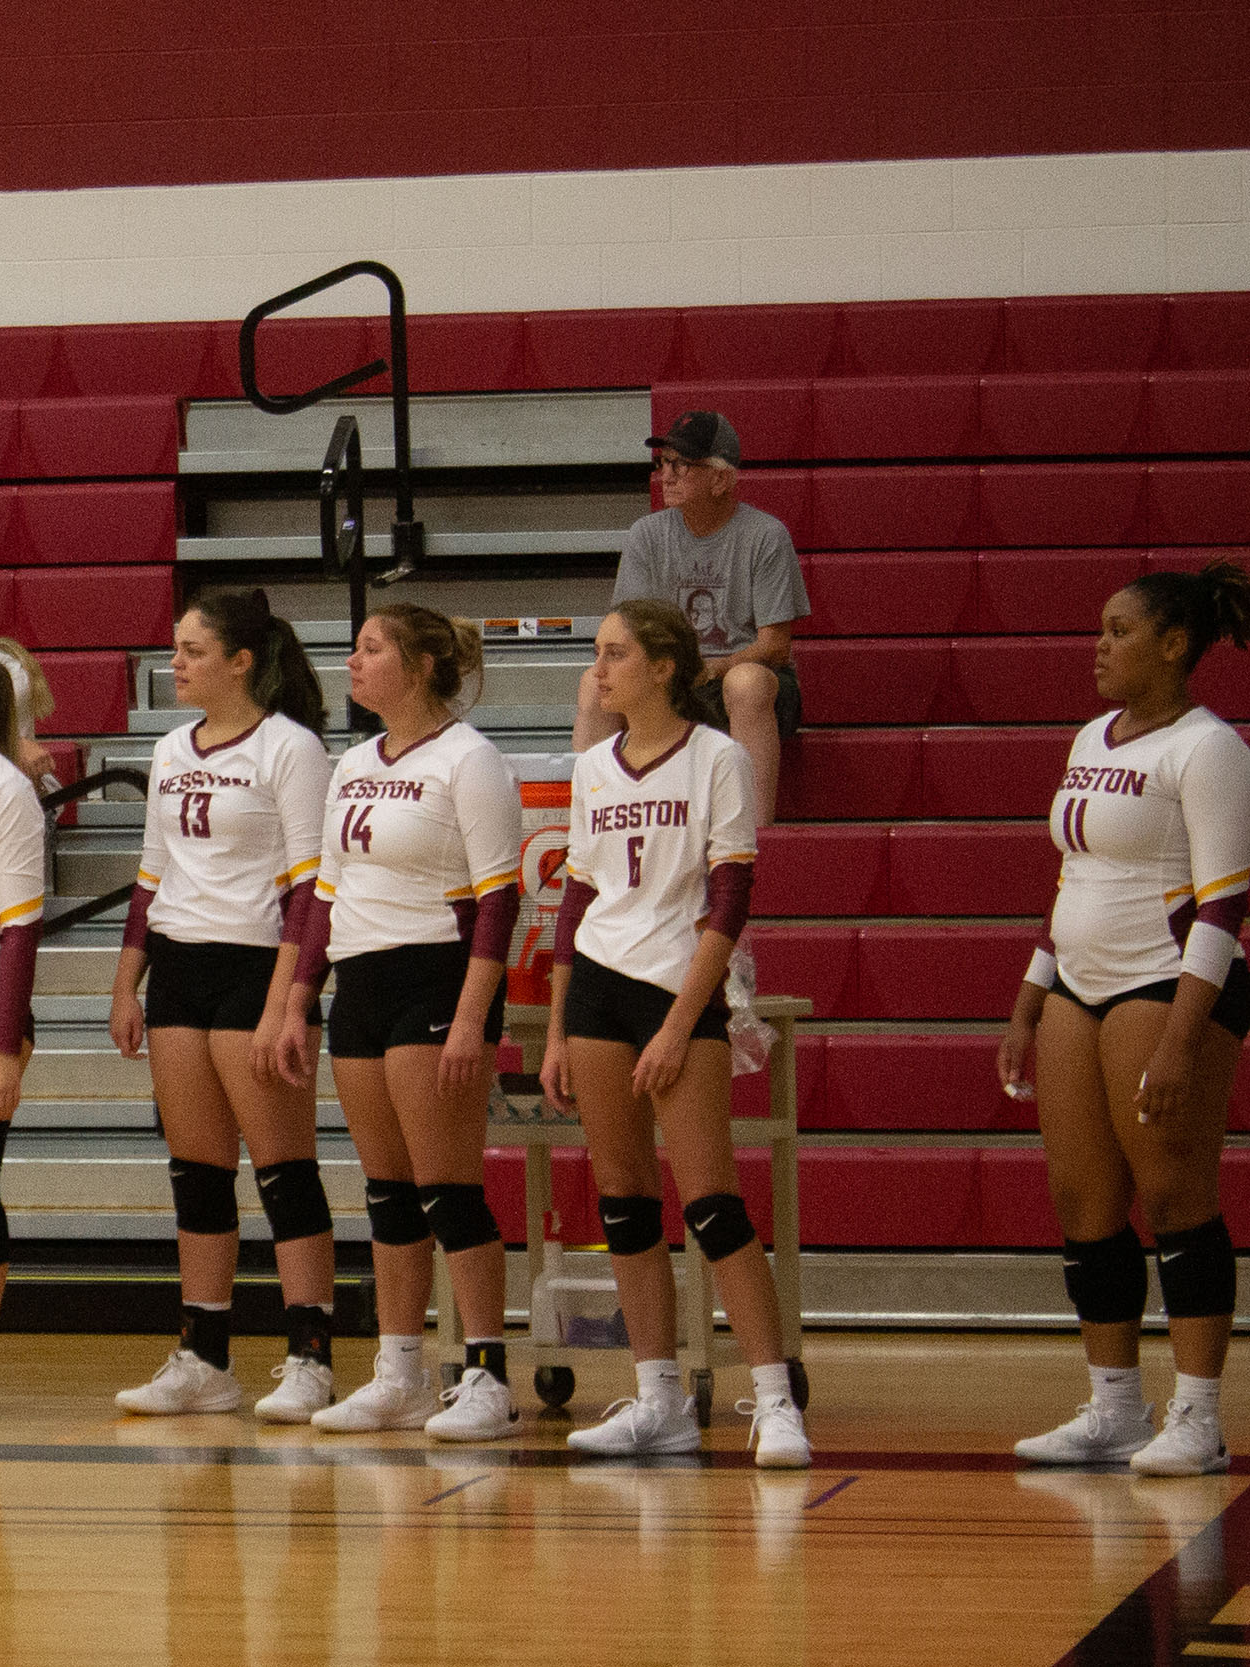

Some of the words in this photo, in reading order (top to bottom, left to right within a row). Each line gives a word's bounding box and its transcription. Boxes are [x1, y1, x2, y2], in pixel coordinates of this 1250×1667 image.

[1059, 766, 1148, 797] ESSTON
[179, 792, 213, 838] 13
[340, 804, 374, 854] 14
[591, 800, 689, 835] HESSTON
[1063, 798, 1090, 853] 11
[627, 836, 644, 888] 6
